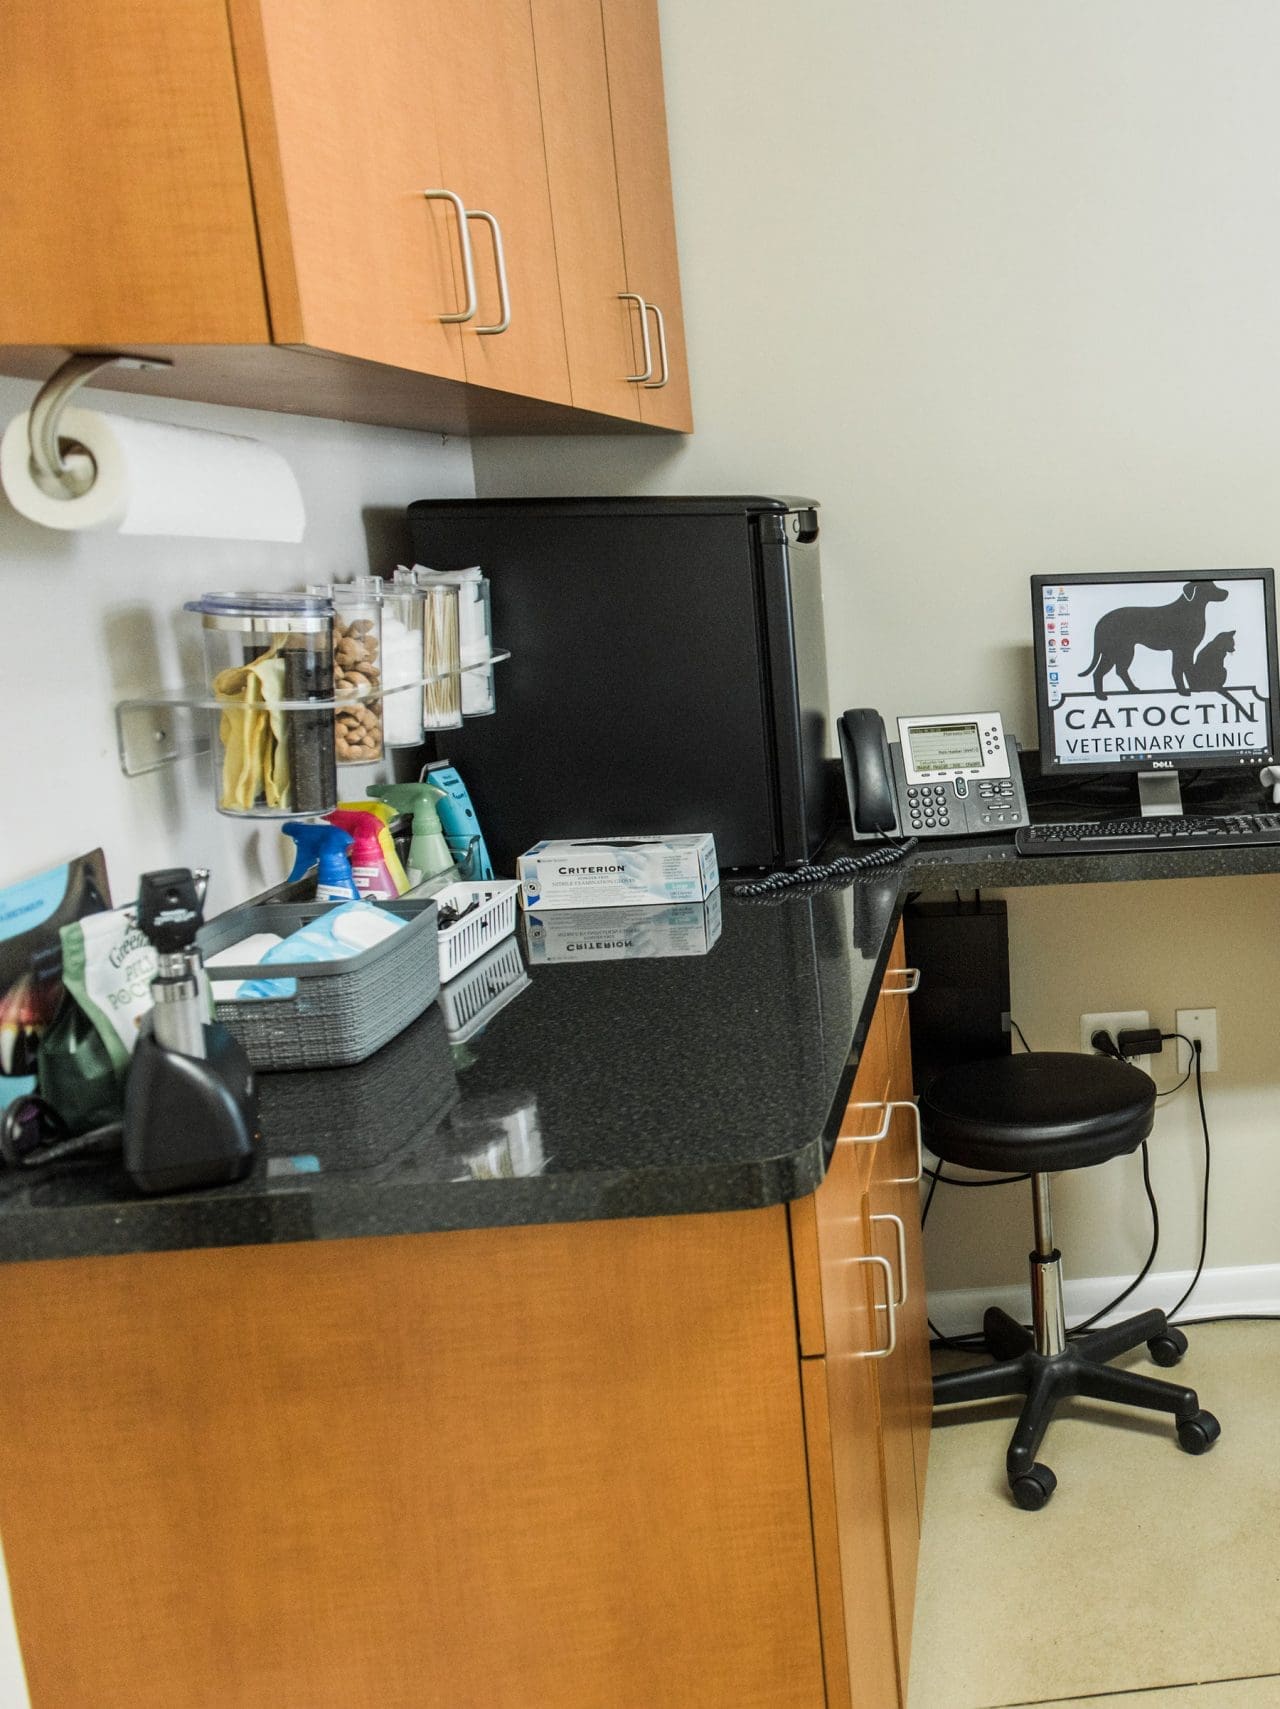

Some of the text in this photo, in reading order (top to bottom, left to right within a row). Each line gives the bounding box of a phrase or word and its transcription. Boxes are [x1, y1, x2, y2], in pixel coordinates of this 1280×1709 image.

[1065, 702, 1259, 730] CATOCTIN
[1066, 731, 1255, 754] VETERINARY CLINIC
[1152, 760, 1175, 769] DELL
[558, 865, 626, 875] CRITERION
